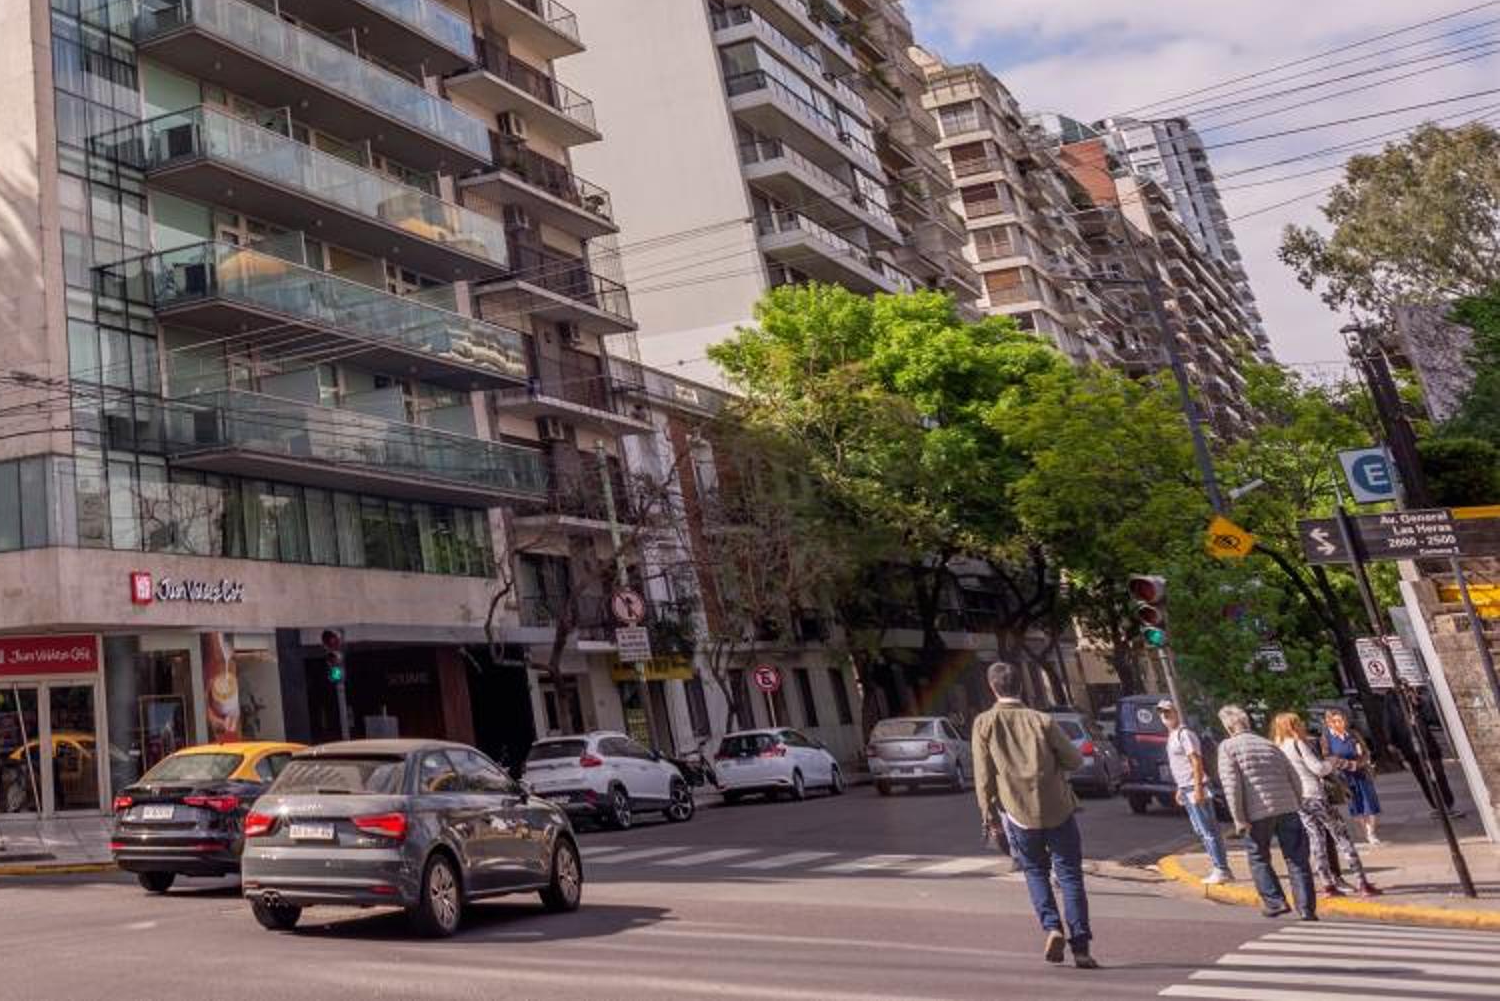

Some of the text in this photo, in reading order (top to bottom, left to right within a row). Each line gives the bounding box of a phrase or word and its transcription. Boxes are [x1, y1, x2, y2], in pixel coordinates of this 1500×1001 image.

[1363, 464, 1390, 486] E
[1401, 511, 1448, 524] General
[1393, 524, 1453, 535] Las Heras
[157, 579, 183, 601] Juan
[184, 580, 221, 604] Valdez
[8, 649, 34, 663] Juan
[36, 647, 69, 661] Valdez
